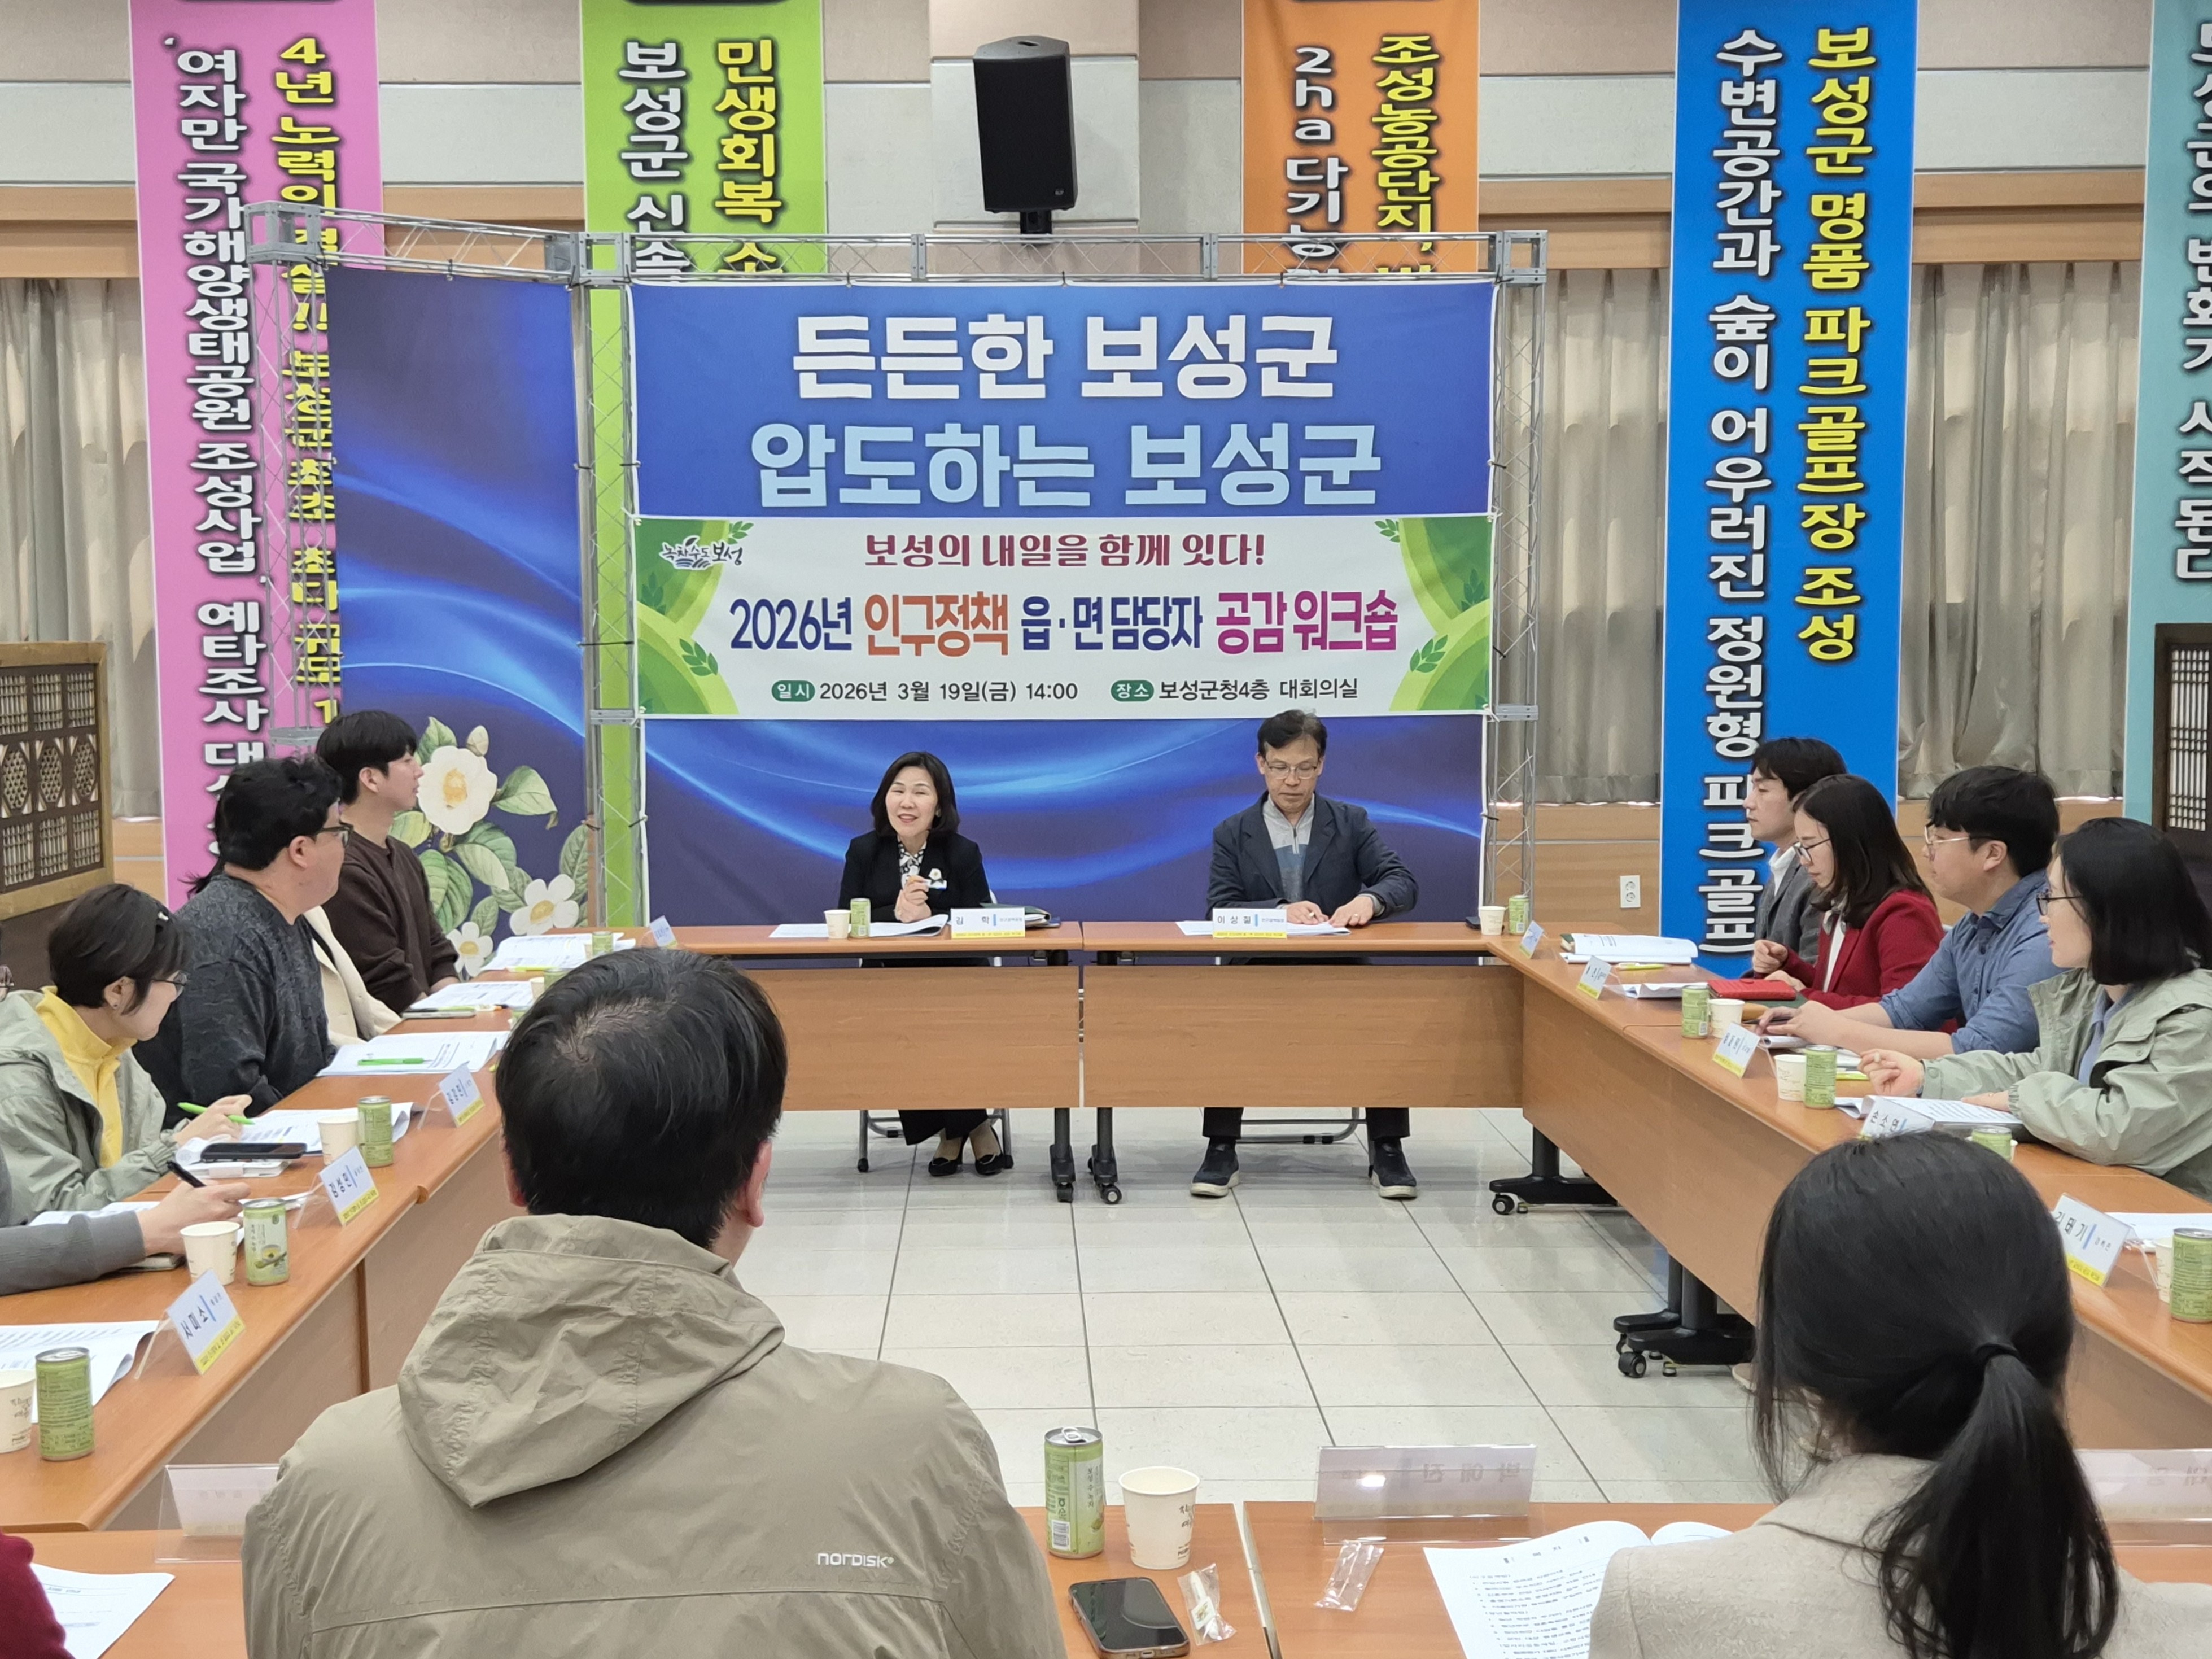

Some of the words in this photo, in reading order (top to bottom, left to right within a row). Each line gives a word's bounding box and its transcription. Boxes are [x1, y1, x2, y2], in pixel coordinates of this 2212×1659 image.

[275, 38, 334, 103] 4년
[619, 41, 688, 177] 보성군
[1806, 27, 1876, 174] 보성군
[714, 39, 782, 223] 민생회복
[1713, 29, 1783, 276] 수변공간과
[1803, 192, 1870, 289] 명품
[177, 163, 255, 430] 국가해양생태공원
[1708, 295, 1776, 390] 숲이
[793, 313, 1053, 399] 든든한
[1081, 315, 1337, 399] 보성군
[751, 423, 1095, 508] 압도하는
[1125, 422, 1381, 505] 보성군
[1797, 307, 1871, 549] 파크골프장
[865, 534, 970, 567] 보성의
[982, 534, 1088, 567] 내일을
[1098, 534, 1170, 566] 함께
[1182, 534, 1265, 566] 잇다!
[1705, 407, 1772, 599] 어우러진
[662, 544, 711, 561] 녹차수도
[712, 541, 743, 565] 보성
[730, 597, 853, 651] 2026년
[864, 591, 1009, 657] 인구정책
[1216, 591, 1288, 654] 공감
[1293, 589, 1398, 651] 워크숍
[1794, 567, 1861, 661] 조성
[197, 601, 269, 731] 예타조사
[777, 683, 811, 699] 일시
[820, 681, 888, 701] 2026년
[898, 681, 930, 701] 3월
[939, 680, 1016, 702] 19일(금)
[1025, 682, 1078, 699] 14:00
[1116, 683, 1150, 698] 장소
[1159, 679, 1270, 700] 보성군청4층
[1280, 678, 1358, 699] 대회의실
[1705, 615, 1763, 758] 정원형
